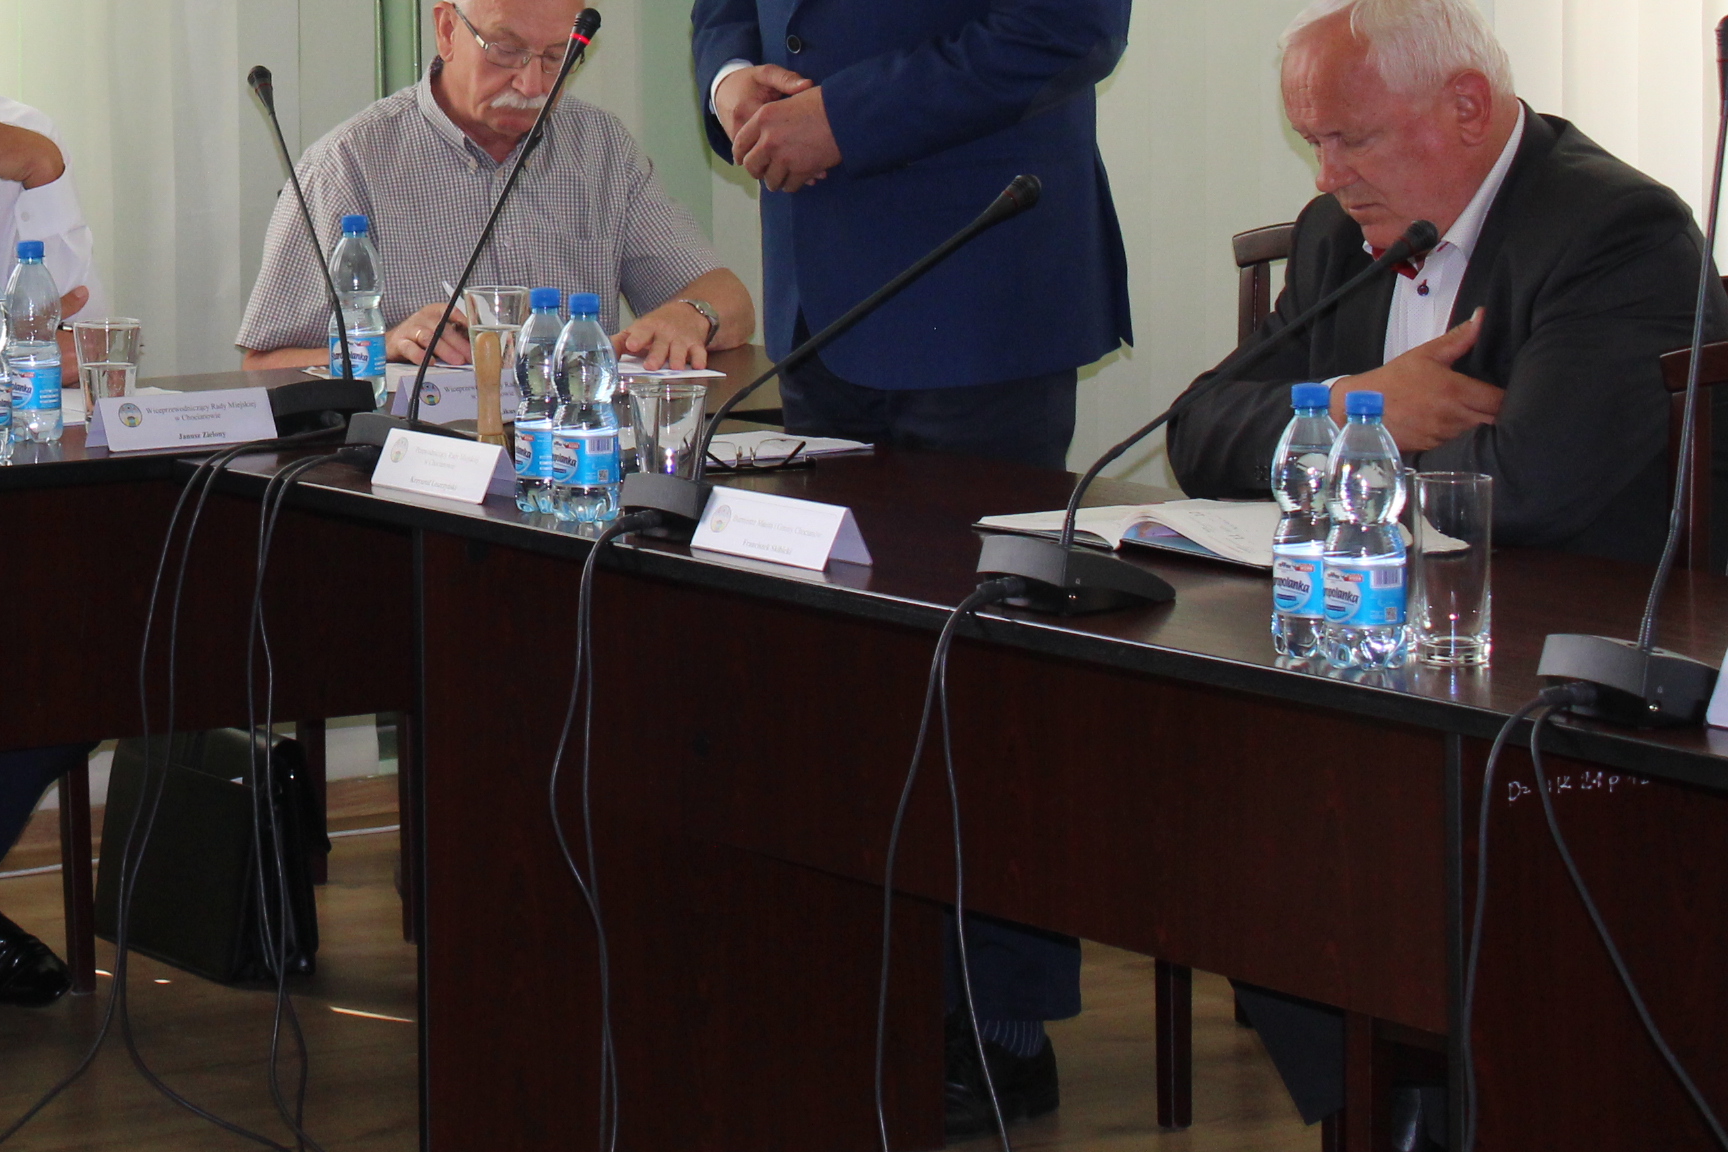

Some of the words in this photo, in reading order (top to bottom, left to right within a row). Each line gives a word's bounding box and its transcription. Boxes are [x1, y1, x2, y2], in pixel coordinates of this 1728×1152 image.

[146, 403, 210, 416] Wiceprzewodniczący
[210, 402, 227, 412] Rady
[228, 399, 257, 410] Miejskiej
[182, 412, 221, 422] Chocianowie
[178, 432, 200, 440] Janusz
[202, 430, 226, 439] Zielony
